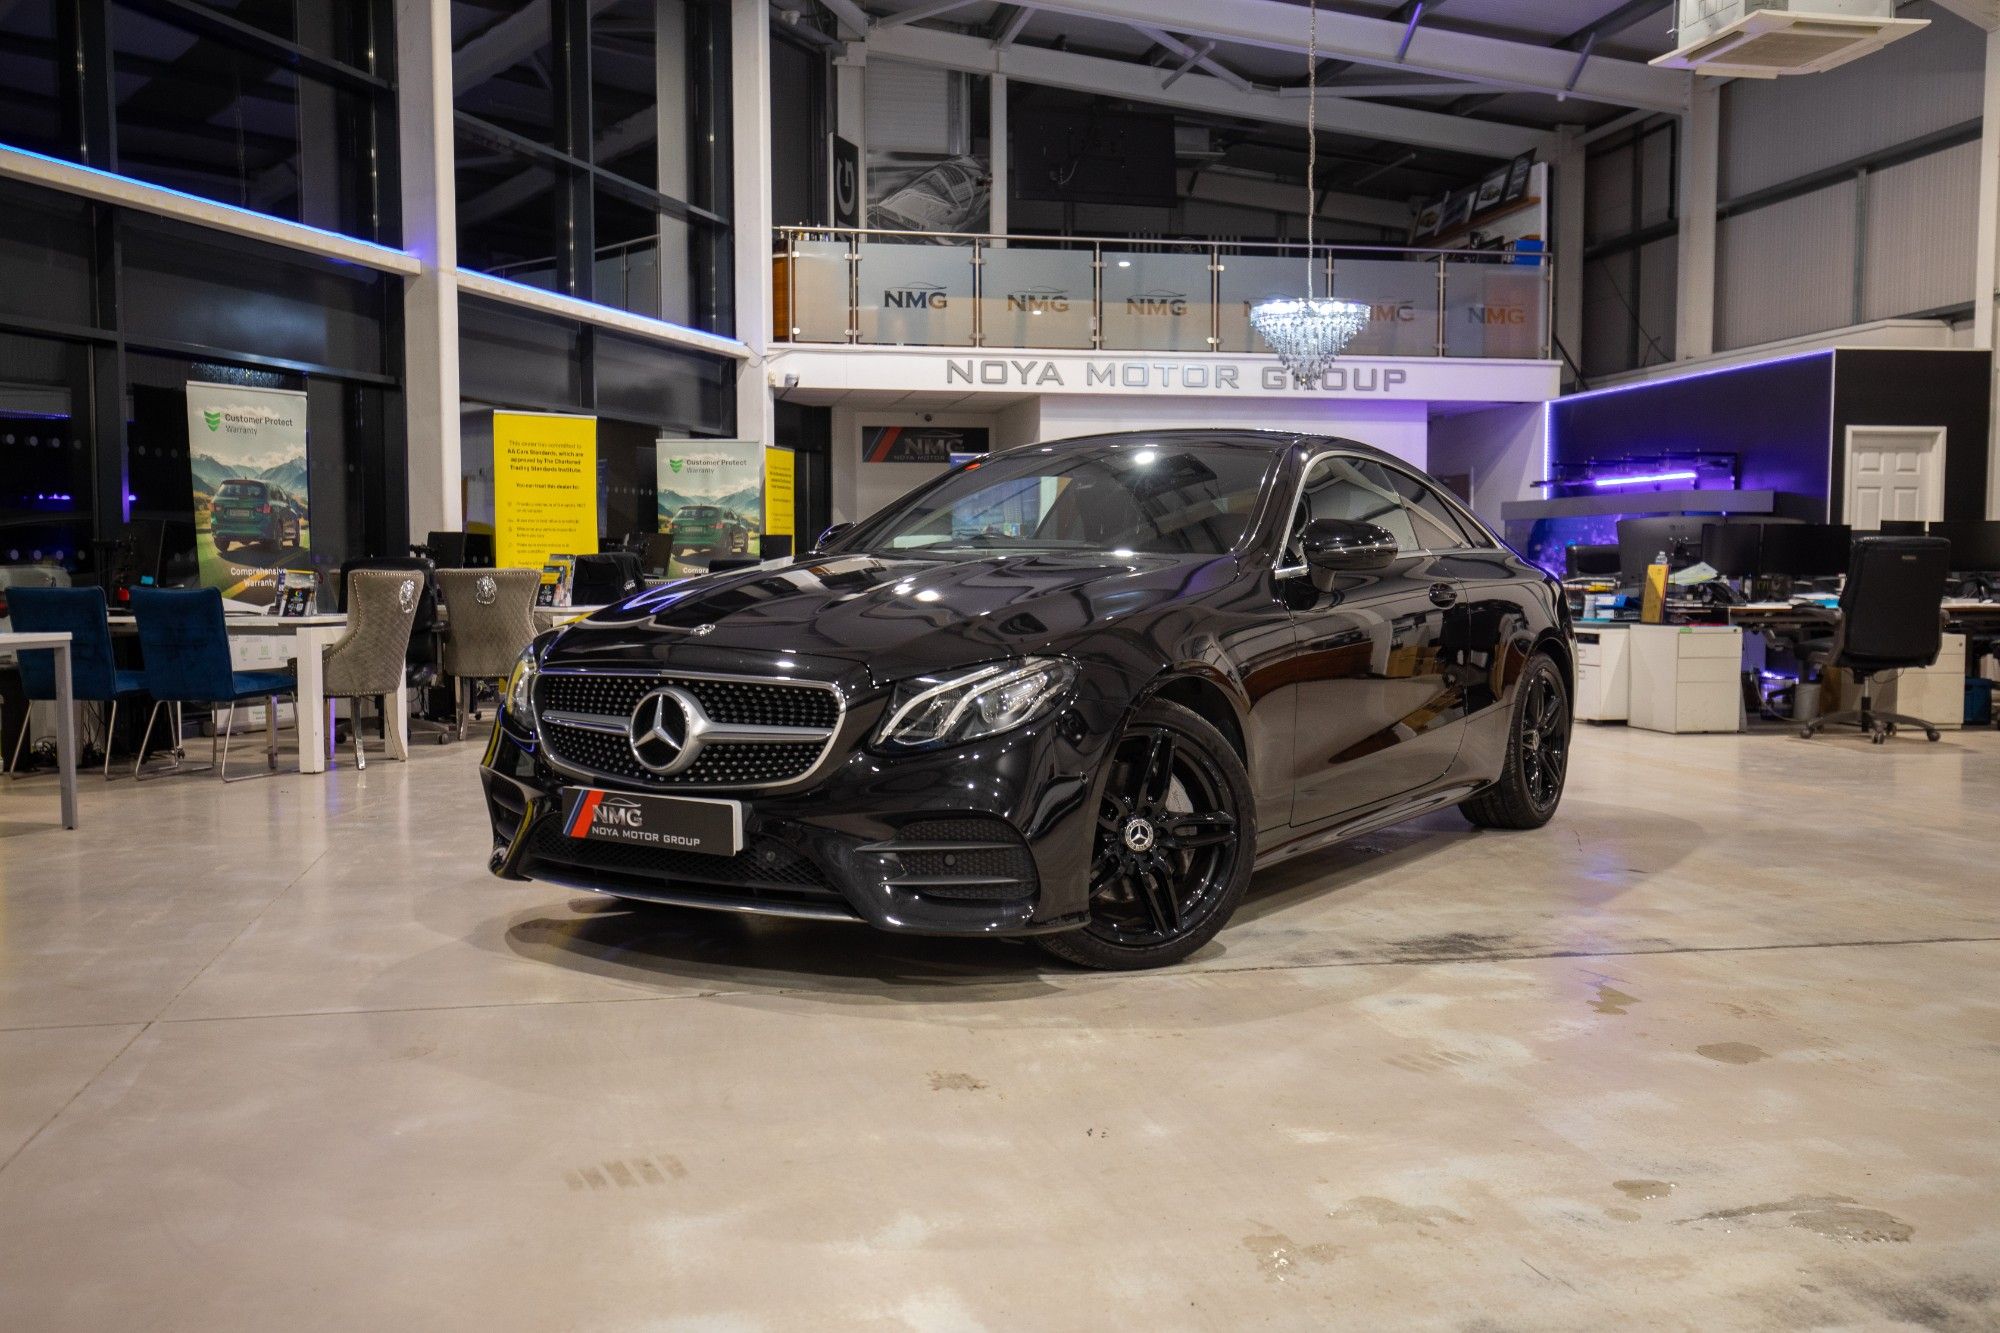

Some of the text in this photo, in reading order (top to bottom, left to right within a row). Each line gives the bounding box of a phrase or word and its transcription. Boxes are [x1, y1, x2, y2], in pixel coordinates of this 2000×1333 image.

[884, 290, 948, 309] NMG
[1007, 294, 1070, 313] NMG
[1126, 298, 1188, 316] NMG
[1369, 304, 1415, 323] MG
[1467, 307, 1527, 325] NMG
[946, 359, 1065, 386] NOYA
[1086, 362, 1240, 389] MOTOR
[224, 413, 293, 427] Customer Protect
[225, 425, 258, 436] Warranty
[904, 438, 965, 455] NMG
[230, 567, 287, 576] Comprehensive
[244, 579, 276, 588] Warranty
[592, 804, 643, 827] NMG
[592, 826, 701, 847] NOYA MOTOR GROUP
